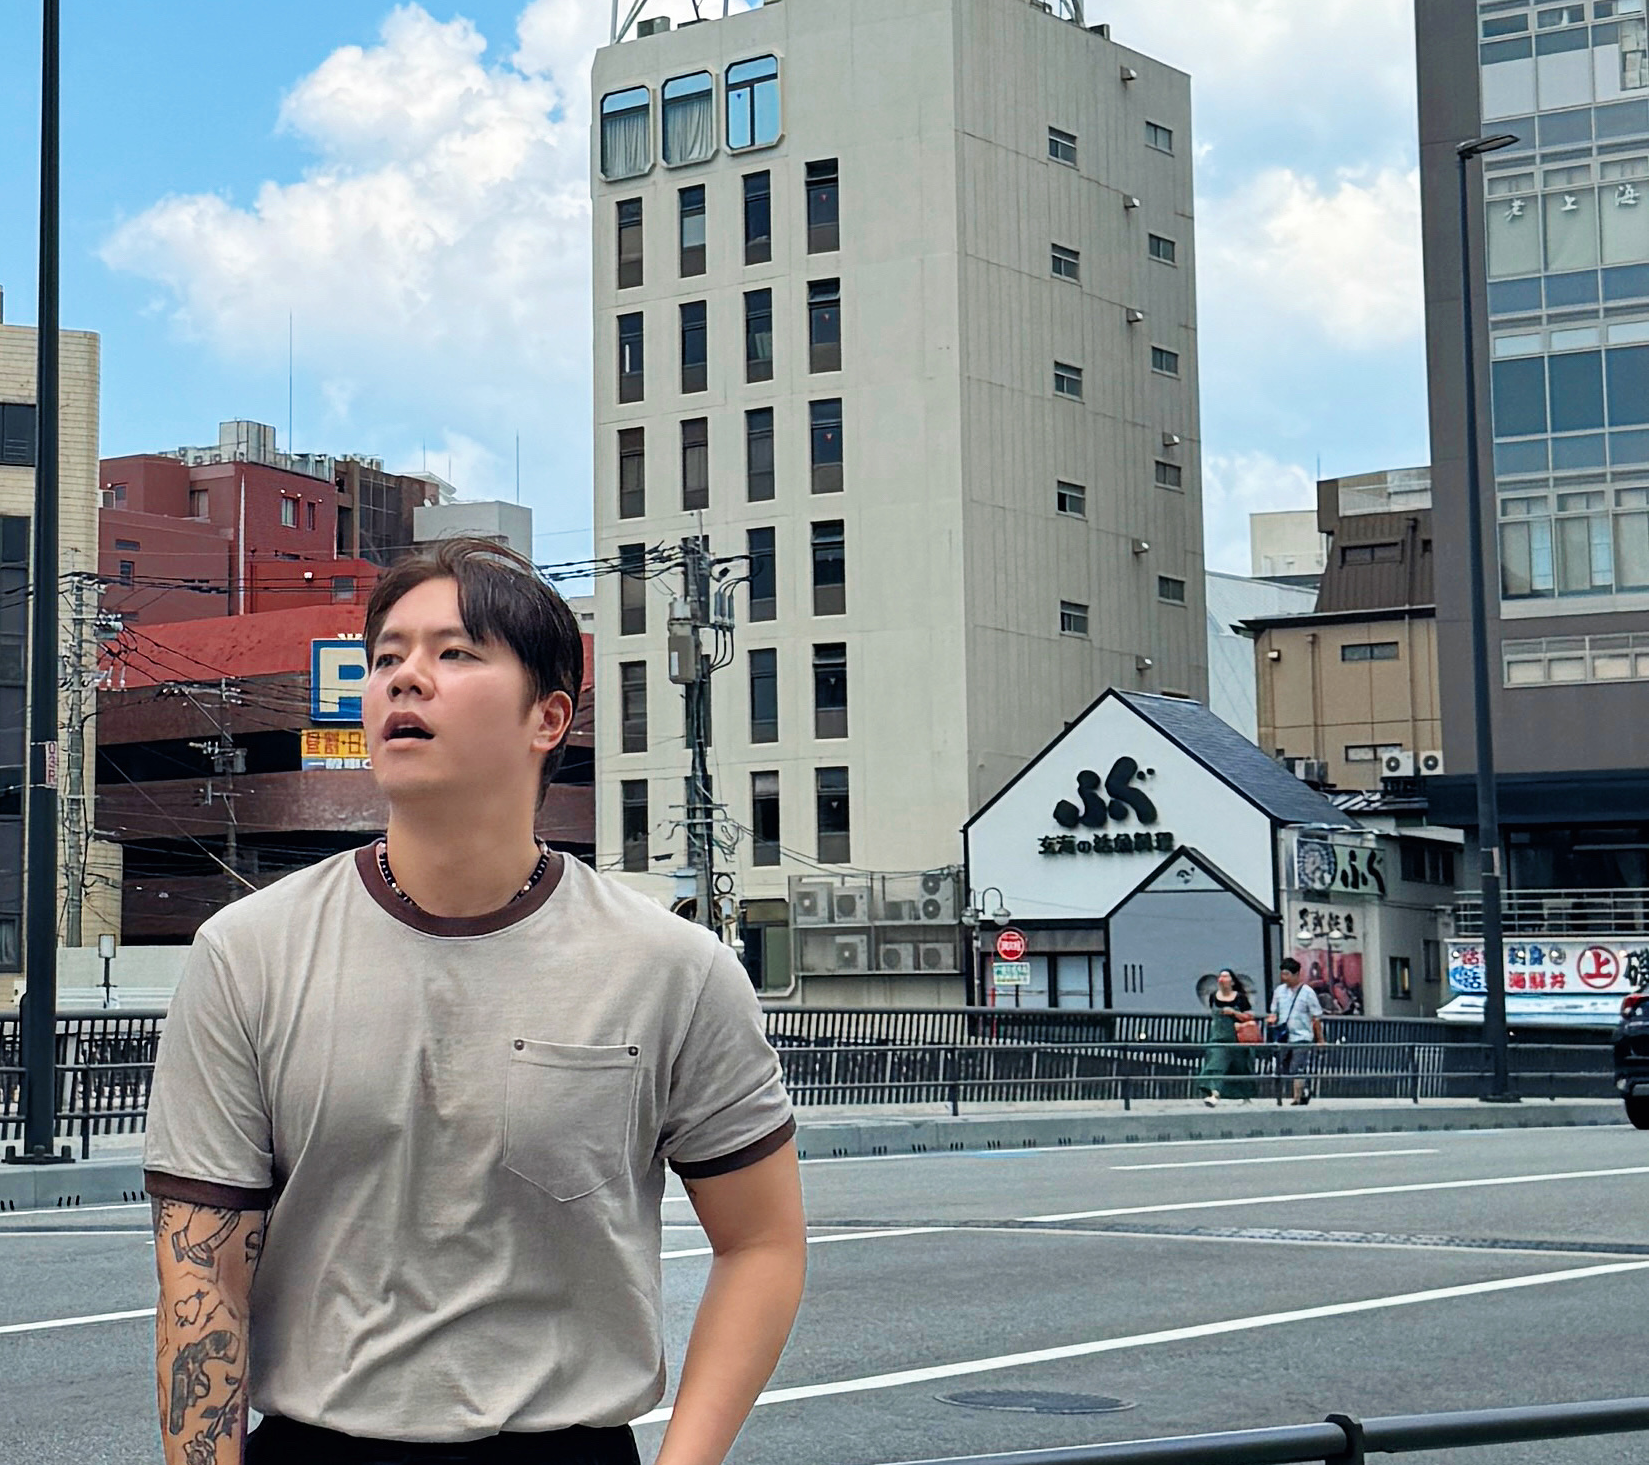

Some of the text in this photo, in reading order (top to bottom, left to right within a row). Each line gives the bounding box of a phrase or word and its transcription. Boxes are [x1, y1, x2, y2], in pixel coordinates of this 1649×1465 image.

[1504, 184, 1641, 222] 老上海
[319, 647, 369, 713] P
[1053, 756, 1157, 828] ふぐ
[1340, 849, 1386, 895] ふぐ
